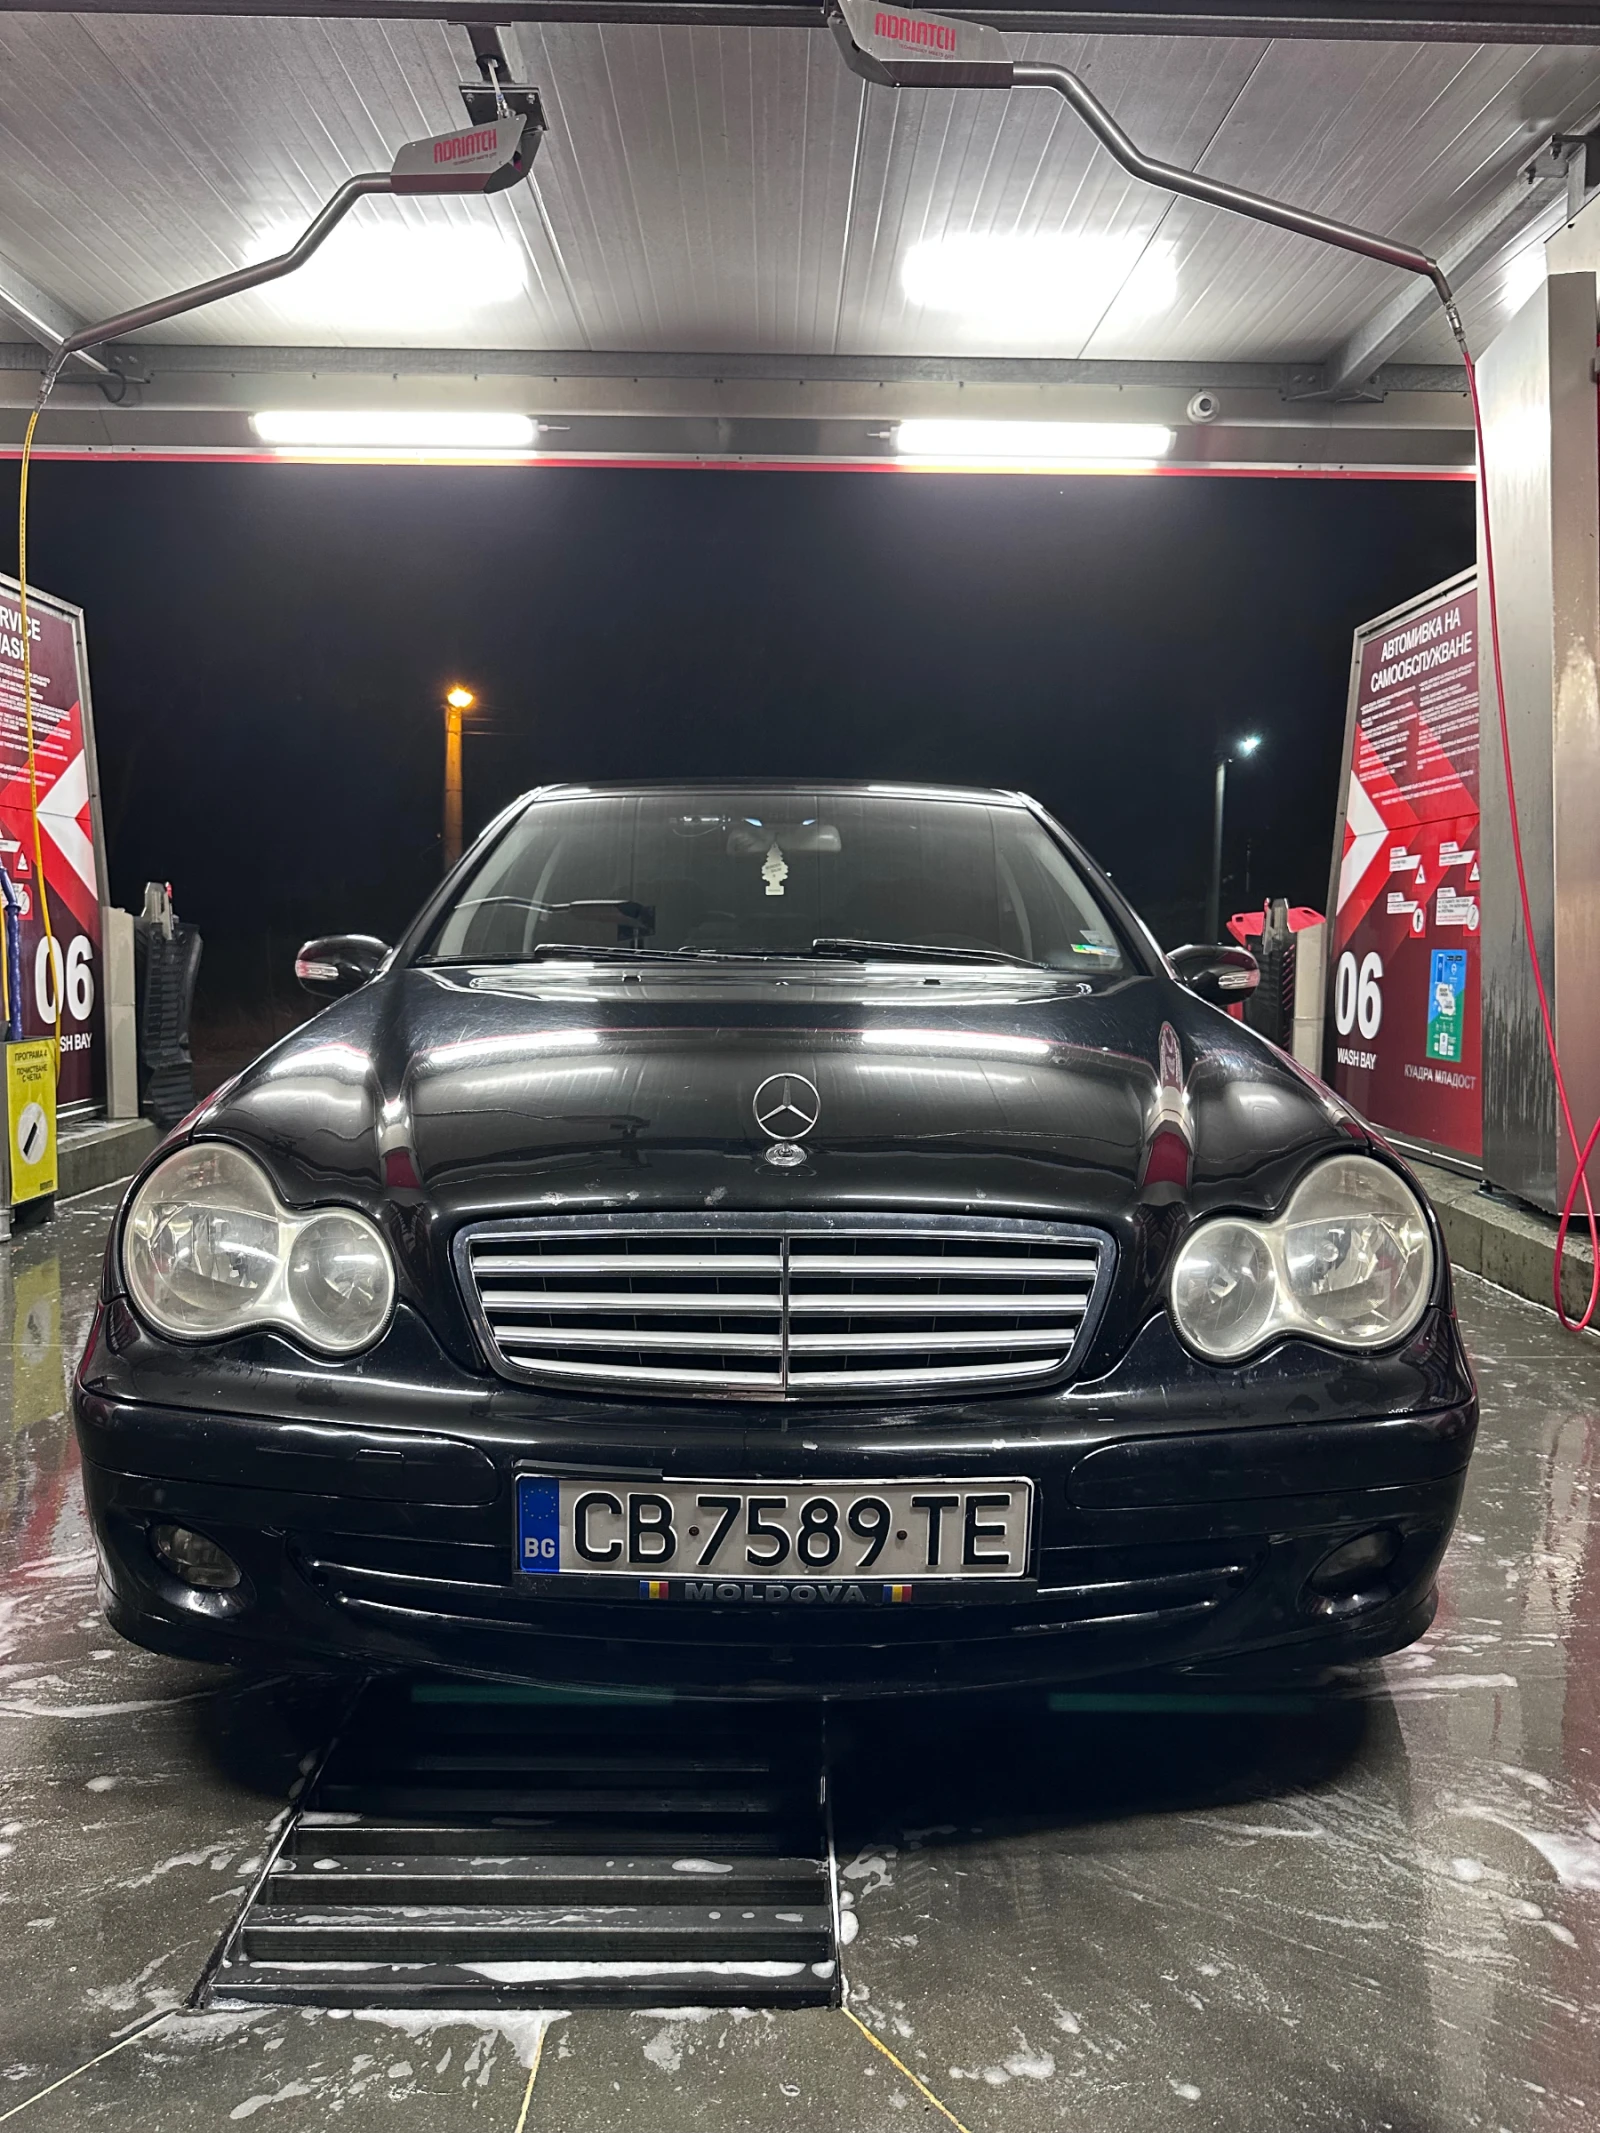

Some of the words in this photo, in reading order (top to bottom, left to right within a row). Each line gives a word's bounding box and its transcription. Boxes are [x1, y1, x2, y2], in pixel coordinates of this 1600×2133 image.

[1380, 615, 1443, 663] АВТОМИВКА
[1445, 607, 1461, 633] НА
[1370, 630, 1473, 693] САМООБСЛУЖВАНЕ
[35, 935, 94, 1024] 06
[1335, 951, 1383, 1039] 06
[75, 1032, 92, 1049] BAY
[15, 1050, 43, 1062] ПРОГРАМА
[1337, 1047, 1359, 1066] WASH
[1359, 1052, 1377, 1070] BAY
[17, 1064, 48, 1075] ПОЧИСТВАНЕ
[1404, 1063, 1434, 1083] КУАДРА
[1434, 1070, 1476, 1090] МЛАДОСТ
[573, 1490, 678, 1564] CB
[695, 1494, 893, 1567] 7589
[911, 1492, 1012, 1566] TE
[524, 1537, 556, 1558] BG
[684, 1582, 867, 1603] MOLDOVA
